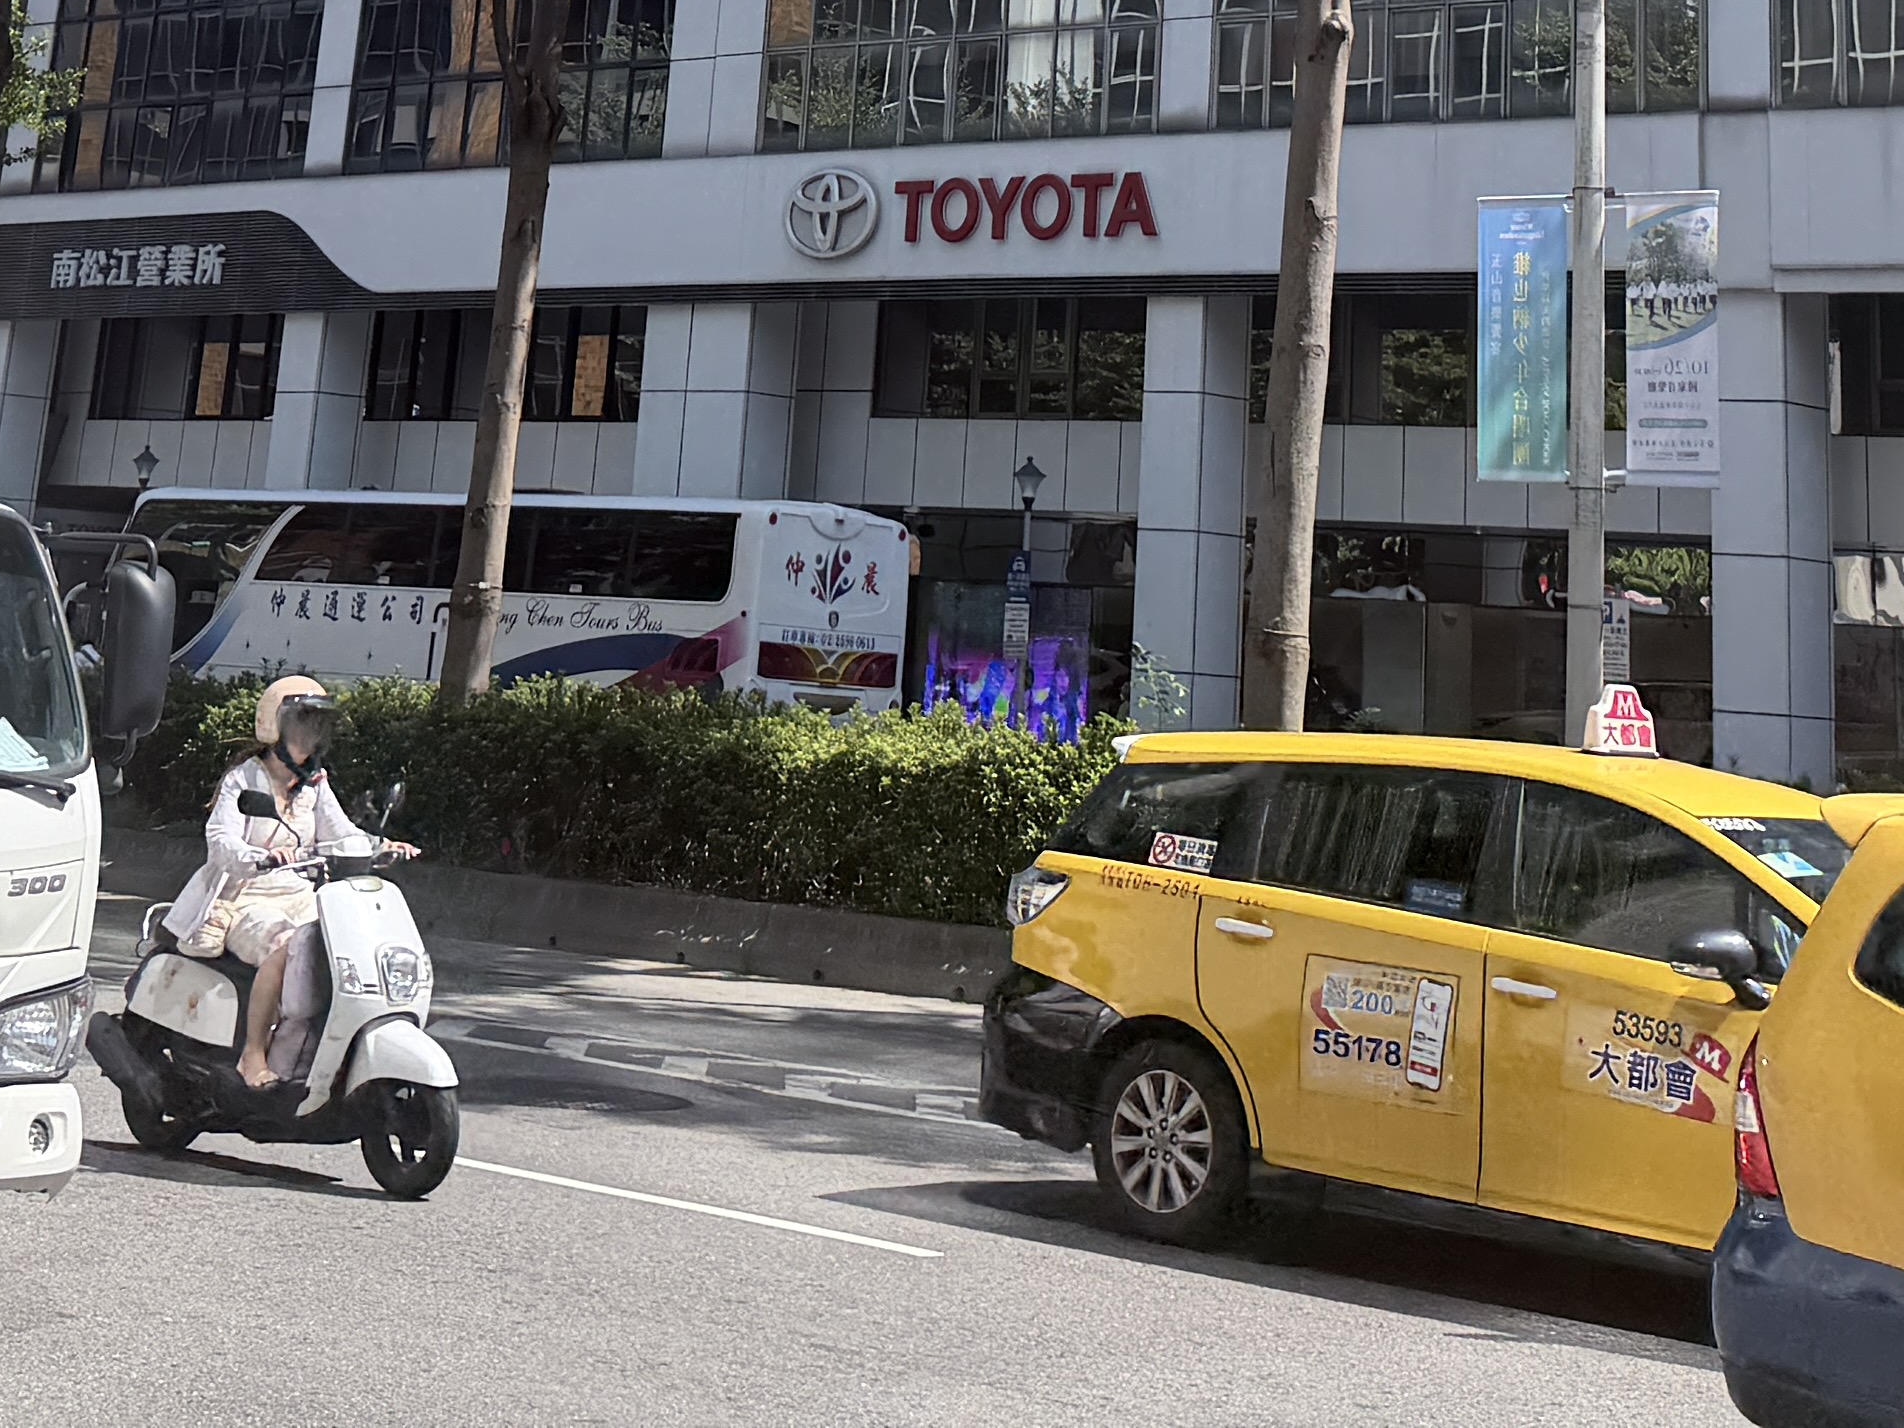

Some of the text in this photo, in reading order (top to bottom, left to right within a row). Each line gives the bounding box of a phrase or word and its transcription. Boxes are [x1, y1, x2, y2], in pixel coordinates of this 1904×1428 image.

[894, 171, 1159, 243] TOYOTA
[50, 243, 227, 289] 南松江營業所
[270, 586, 425, 625] 仲晨通運公司
[626, 601, 663, 632] Bus
[7, 874, 66, 897] 300
[1351, 989, 1394, 1015] 200
[1312, 1028, 1402, 1067] 55178
[1612, 1009, 1683, 1048] 53593
[1588, 1042, 1697, 1102] 大都會
